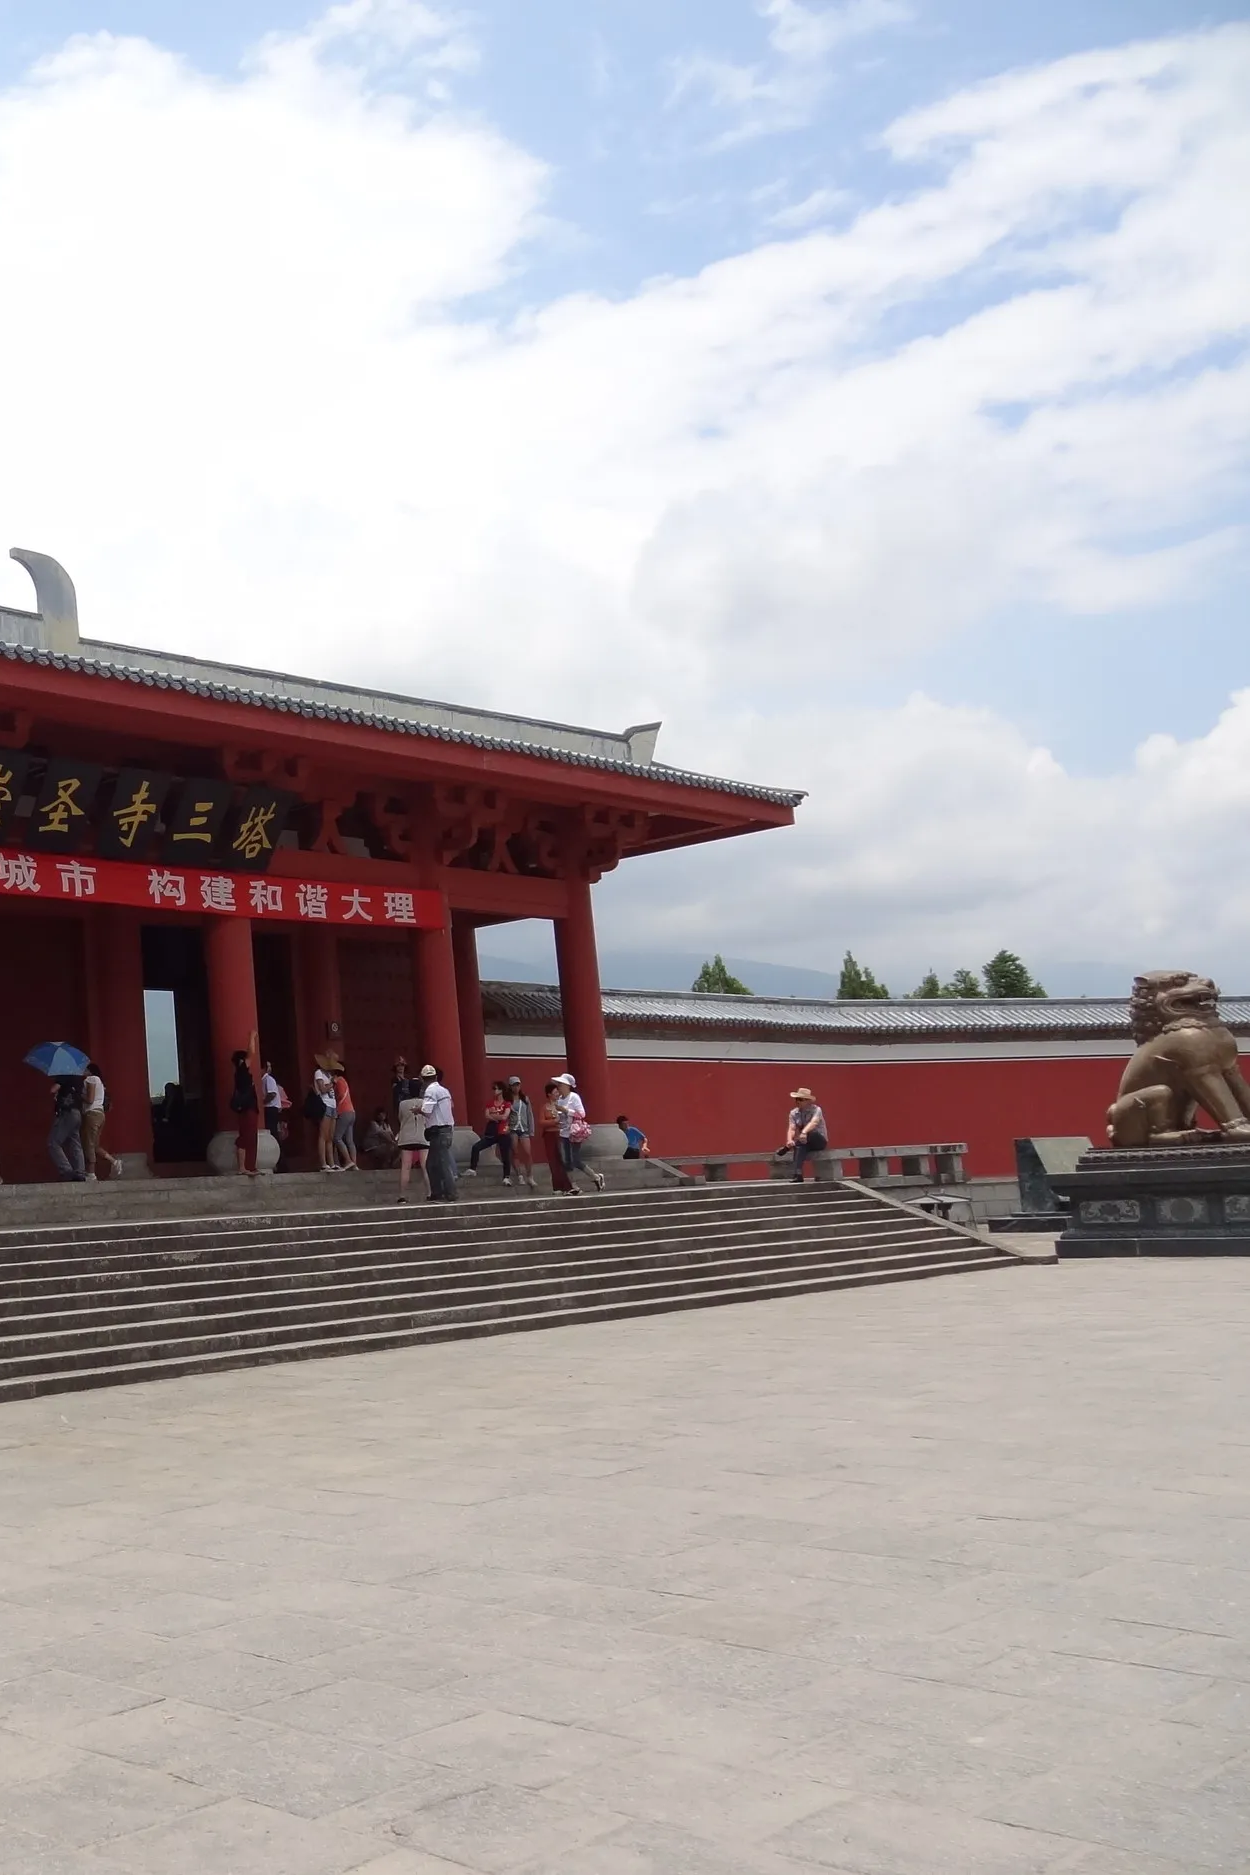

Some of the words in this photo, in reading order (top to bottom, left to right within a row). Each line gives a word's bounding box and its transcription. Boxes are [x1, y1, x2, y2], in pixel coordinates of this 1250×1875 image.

[147, 868, 417, 924] 构建和谐大理
